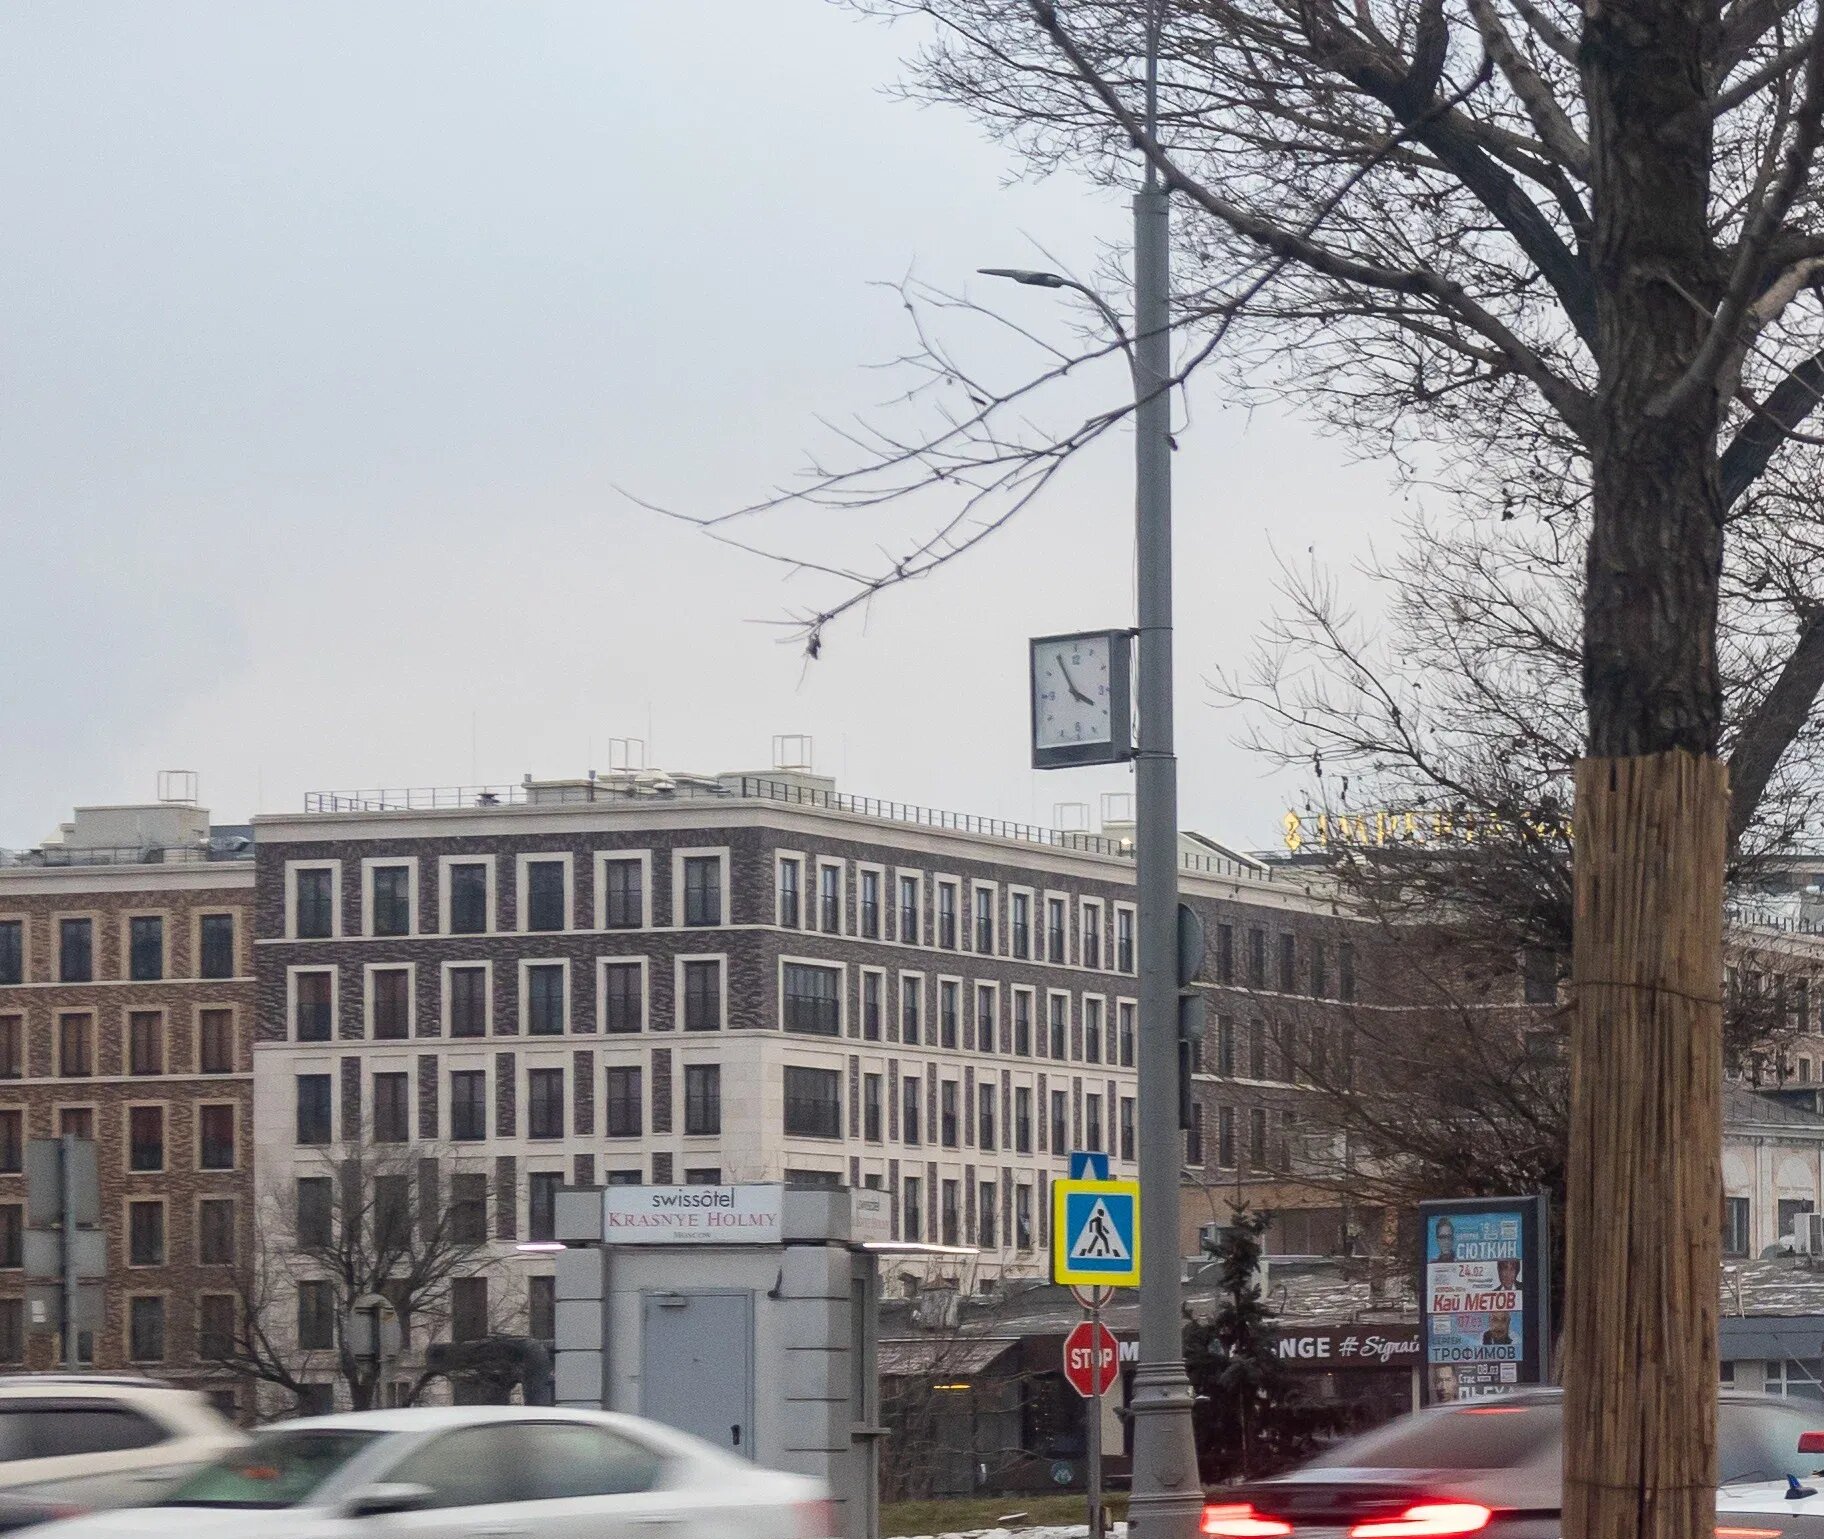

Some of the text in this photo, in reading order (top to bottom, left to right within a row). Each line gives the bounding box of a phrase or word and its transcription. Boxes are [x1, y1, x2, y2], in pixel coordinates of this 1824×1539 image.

[651, 1187, 735, 1208] swissôtel
[608, 1212, 777, 1227] KRASNYE HOLMY
[1456, 1241, 1517, 1260] СЮТКИН
[1464, 1291, 1516, 1311] МЕТОВ
[1432, 1346, 1516, 1361] ТРОФИМОВ
